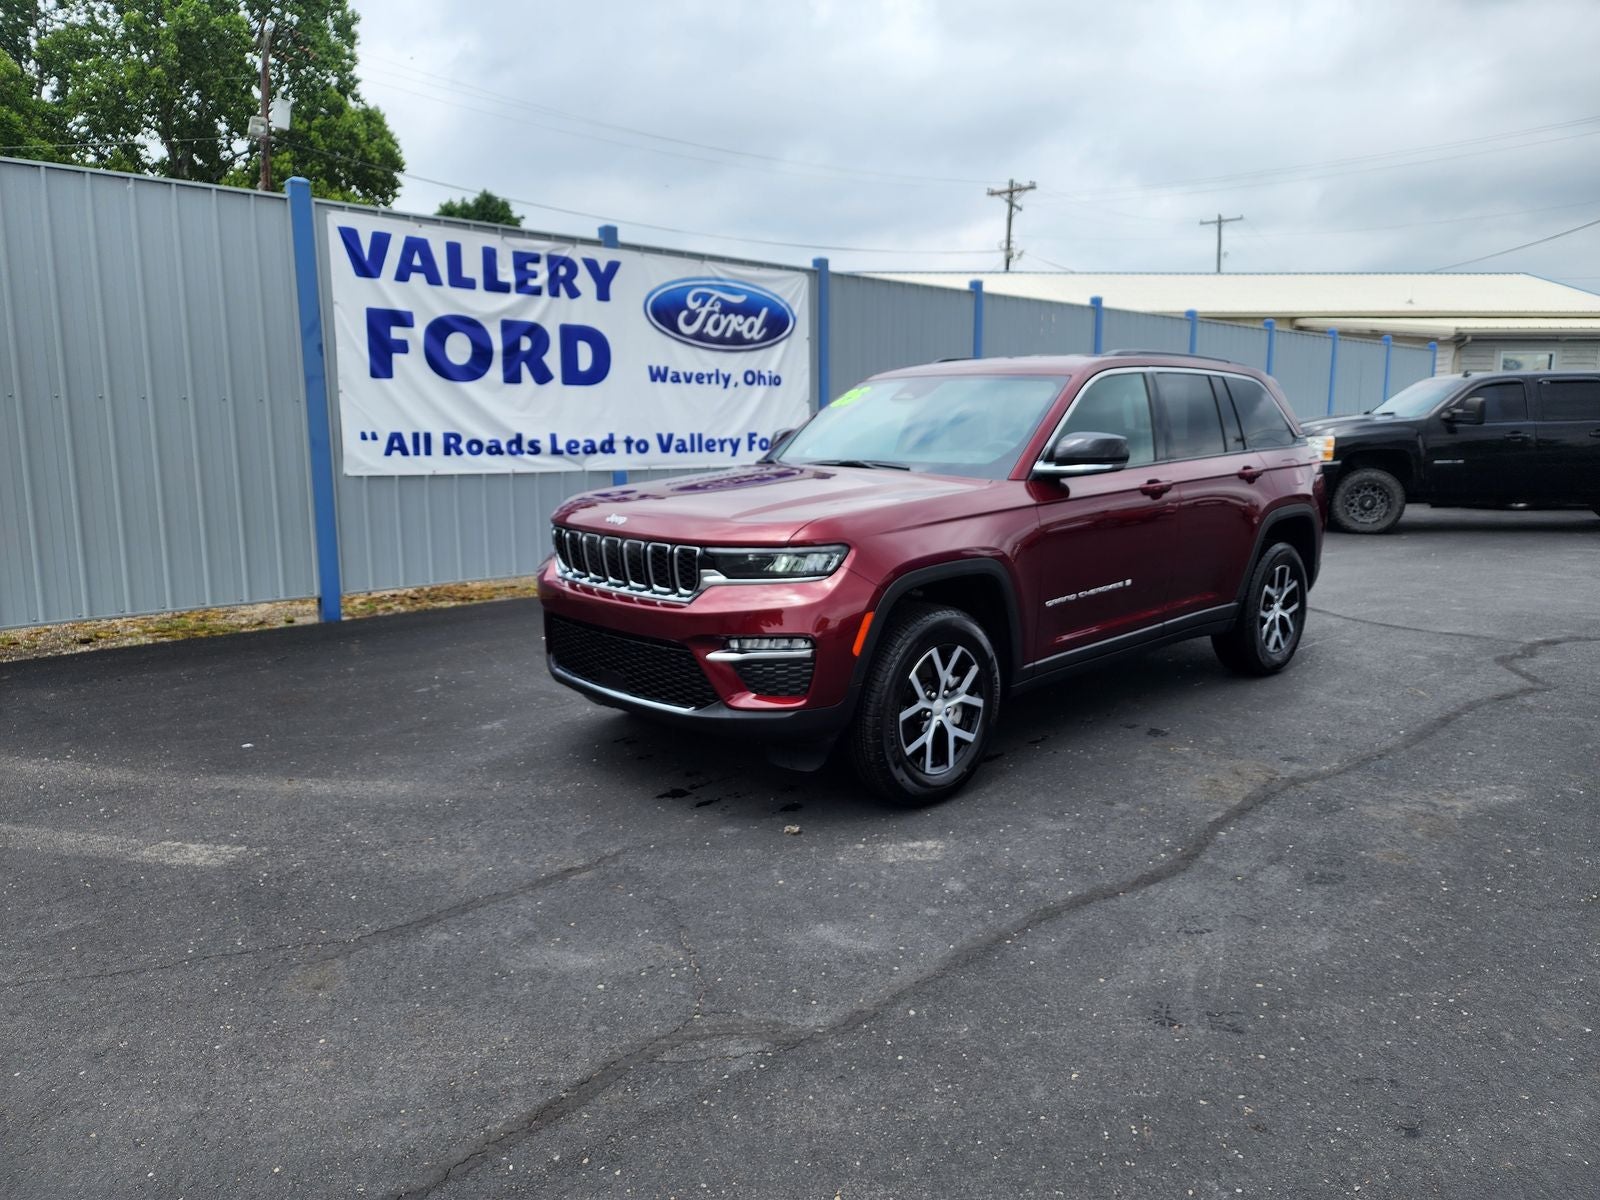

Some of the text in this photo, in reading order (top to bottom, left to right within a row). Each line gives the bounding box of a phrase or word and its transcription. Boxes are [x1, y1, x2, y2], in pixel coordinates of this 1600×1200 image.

[337, 226, 622, 302] VALLERY
[677, 287, 769, 340] Ford
[365, 307, 611, 386] FORD
[648, 365, 782, 389] Waverly, Ohio
[442, 431, 542, 456] Roads
[549, 432, 617, 456] Lead
[624, 432, 650, 454] to
[656, 432, 741, 457] Vallery
[747, 432, 770, 452] Fo
